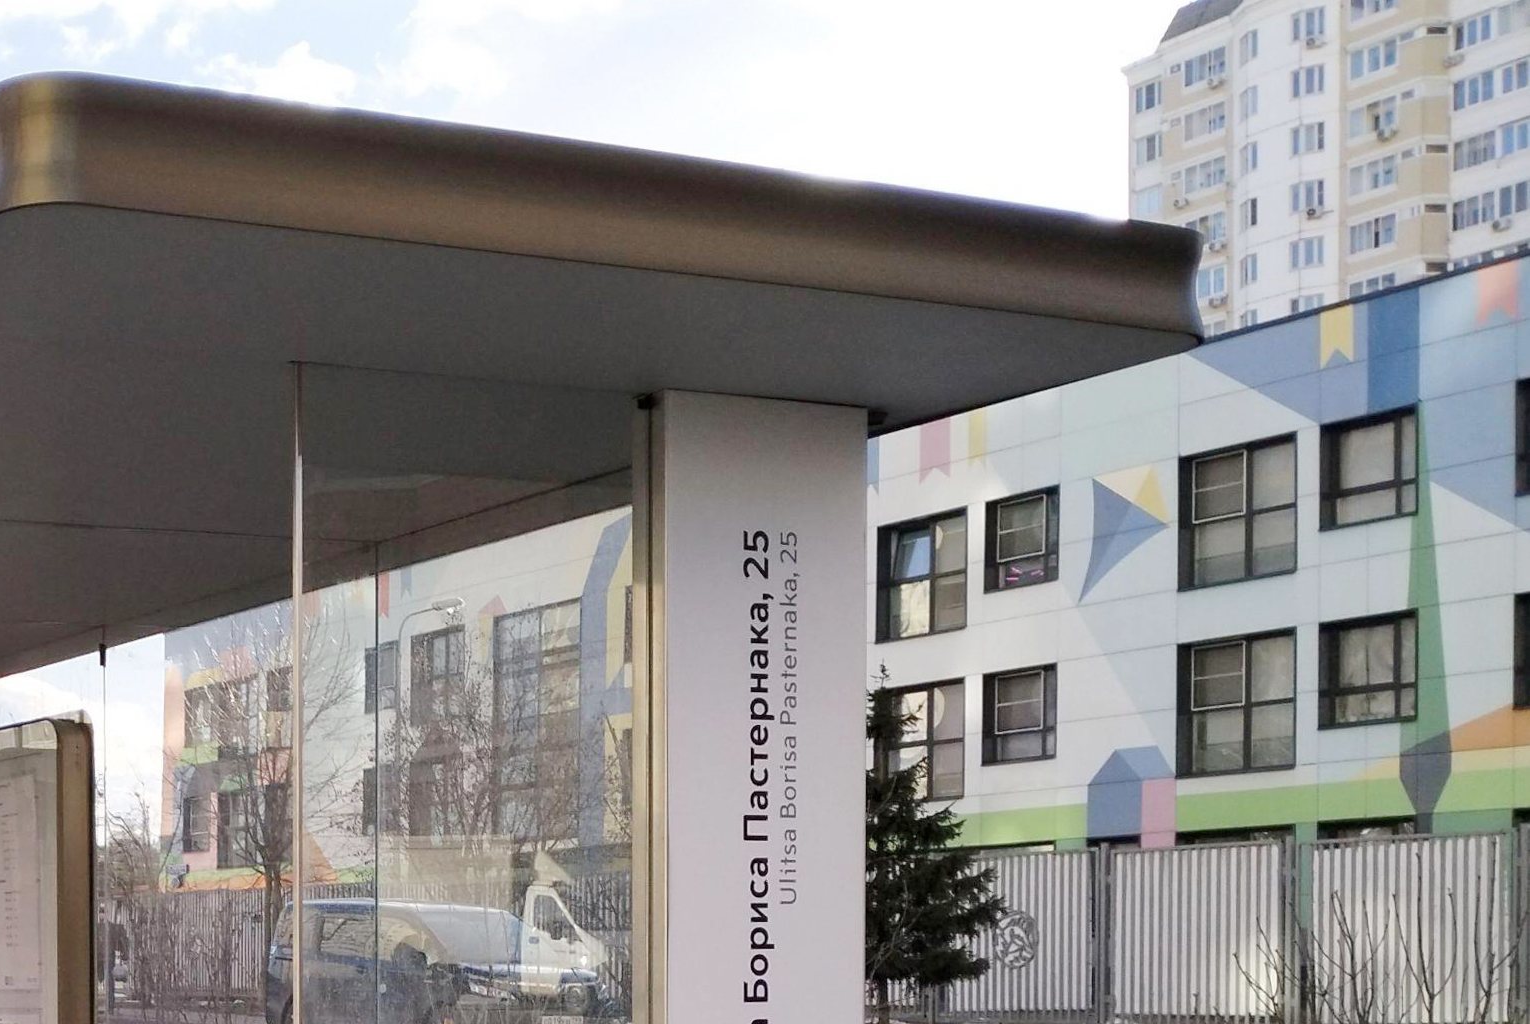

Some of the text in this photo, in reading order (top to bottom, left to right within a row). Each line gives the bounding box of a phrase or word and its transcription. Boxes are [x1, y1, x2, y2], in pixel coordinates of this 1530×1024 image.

[743, 530, 770, 580] 25
[743, 592, 775, 842] Пастернака,
[778, 531, 801, 906] Ulitsa Borisa Pasternaka, 25
[743, 857, 775, 1003] Бориса
